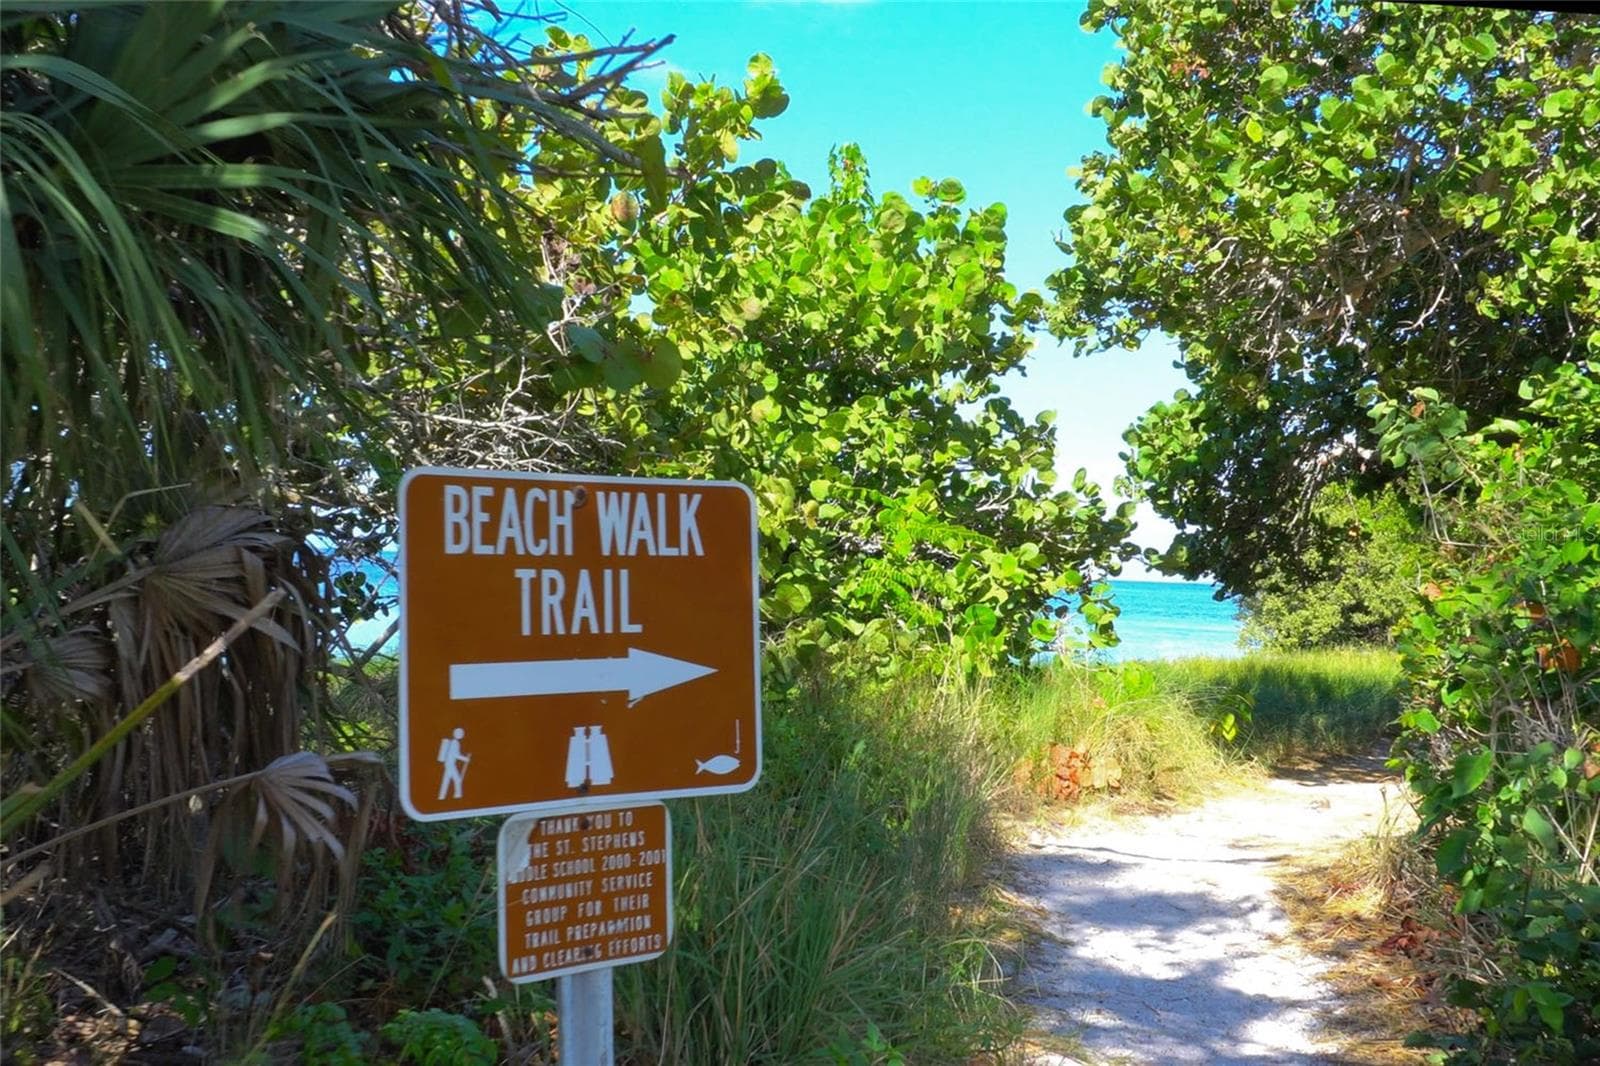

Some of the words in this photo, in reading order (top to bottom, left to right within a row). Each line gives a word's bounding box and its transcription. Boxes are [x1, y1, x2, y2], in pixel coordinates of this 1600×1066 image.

[444, 485, 573, 556] BEACH
[596, 491, 704, 556] WALK
[514, 569, 643, 636] TRAIL
[540, 816, 580, 836] THANK
[586, 814, 612, 831] YOU
[619, 811, 633, 827] TO
[556, 839, 575, 856] ST.
[582, 831, 645, 852] STEPHENS
[553, 857, 596, 878] SCHOOL
[522, 880, 594, 905] COMMUNITY
[602, 872, 654, 893] SERVICE
[526, 906, 568, 927] GROUP
[577, 900, 602, 918] FOR
[614, 893, 650, 913] THEIR
[524, 929, 561, 949] TRAIL
[567, 915, 652, 941] PREPARATION
[512, 955, 538, 975] AND
[608, 934, 662, 958] EFFORTS
